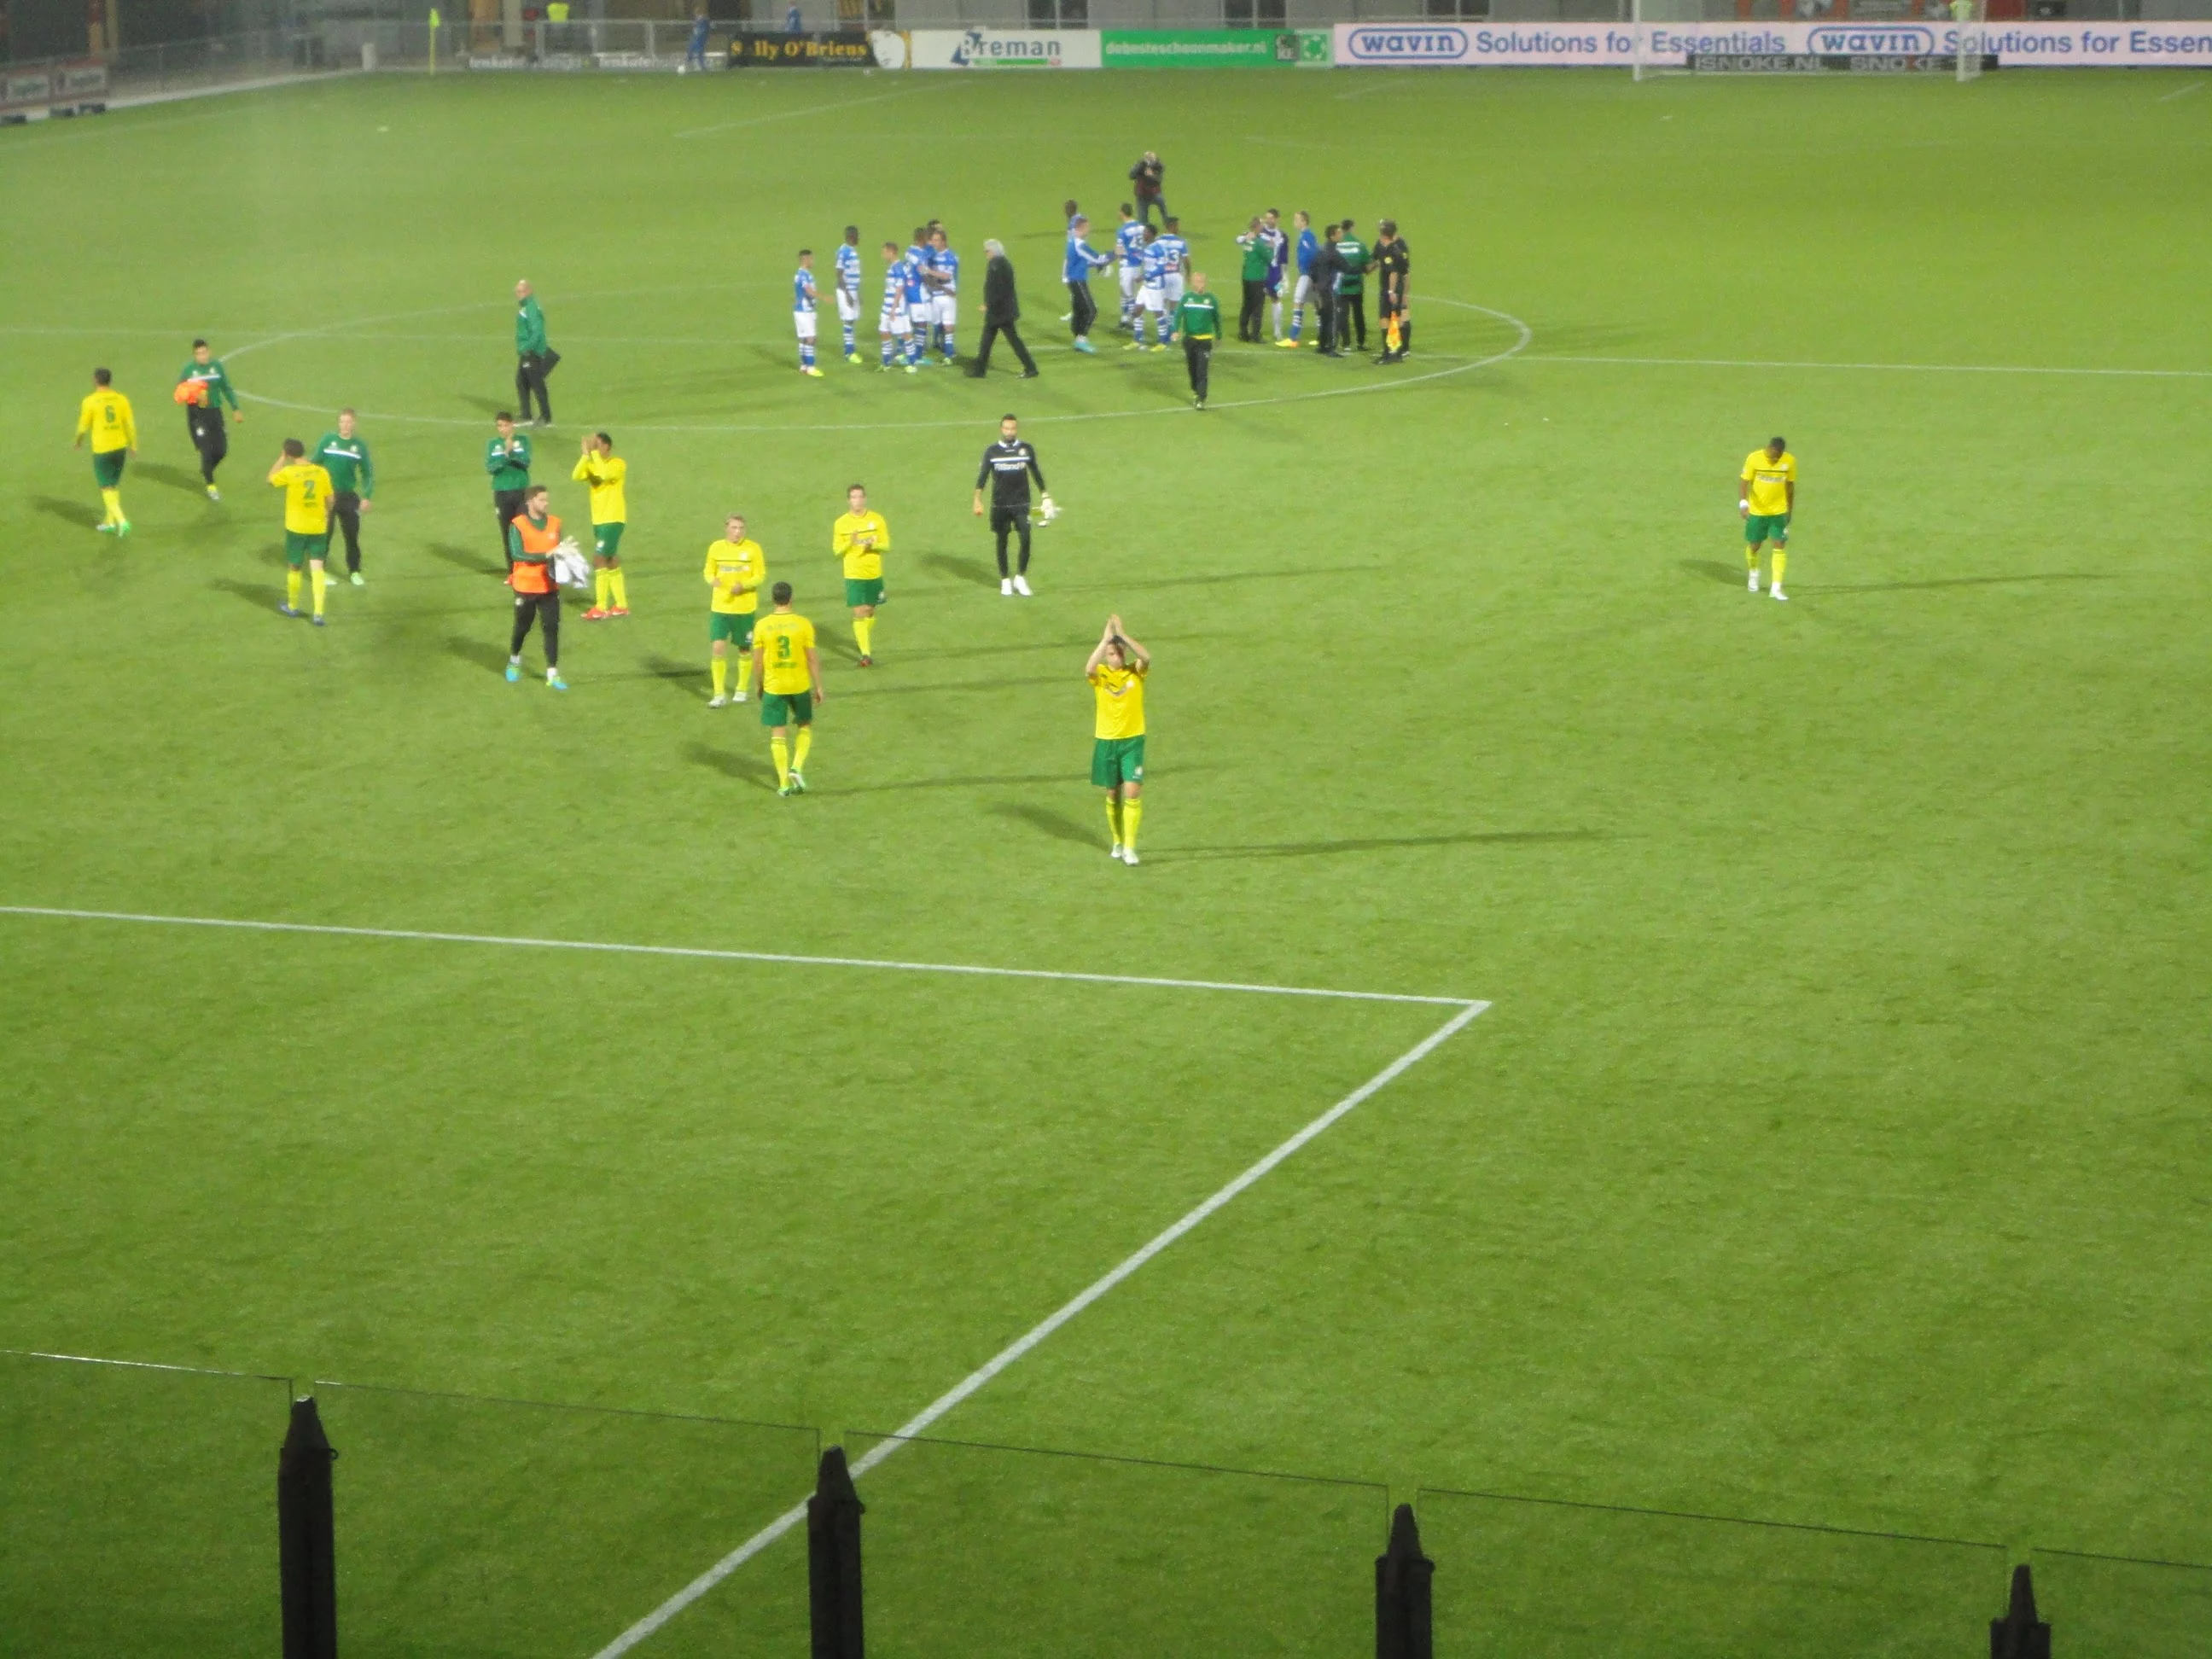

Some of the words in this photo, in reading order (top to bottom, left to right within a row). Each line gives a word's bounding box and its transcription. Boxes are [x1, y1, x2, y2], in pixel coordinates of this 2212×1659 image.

[1361, 34, 1455, 53] wavin
[1476, 31, 1598, 53] Solutions
[1651, 31, 1785, 55] Essentials
[1820, 33, 1921, 53] wavin
[2081, 31, 2120, 53] for
[104, 405, 117, 424] 6
[303, 479, 316, 500] 2
[777, 635, 791, 660] 3
